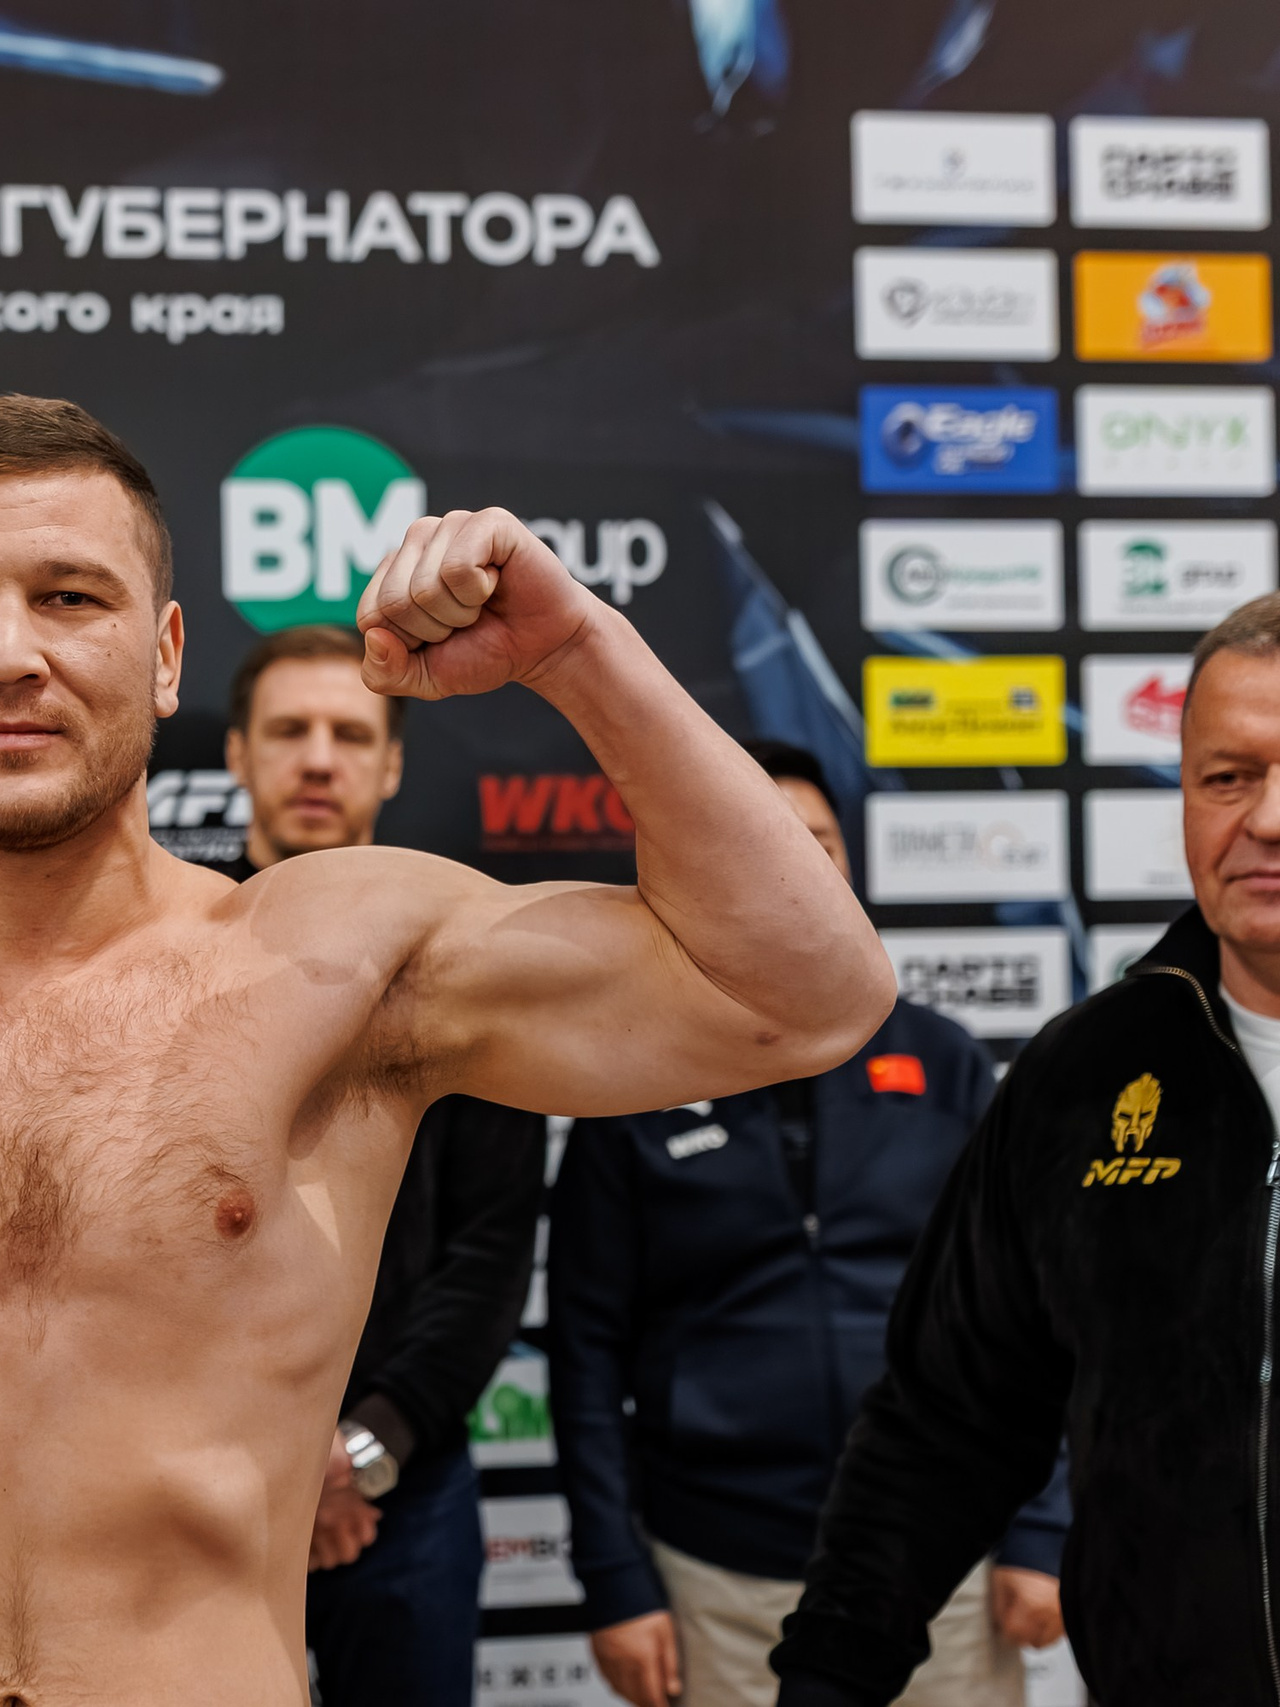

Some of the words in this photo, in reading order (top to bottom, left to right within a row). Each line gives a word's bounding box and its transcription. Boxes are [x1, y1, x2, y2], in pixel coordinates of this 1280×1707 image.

[131, 293, 285, 345] края
[1101, 411, 1249, 451] ONYX
[1081, 1157, 1181, 1188] MFP
